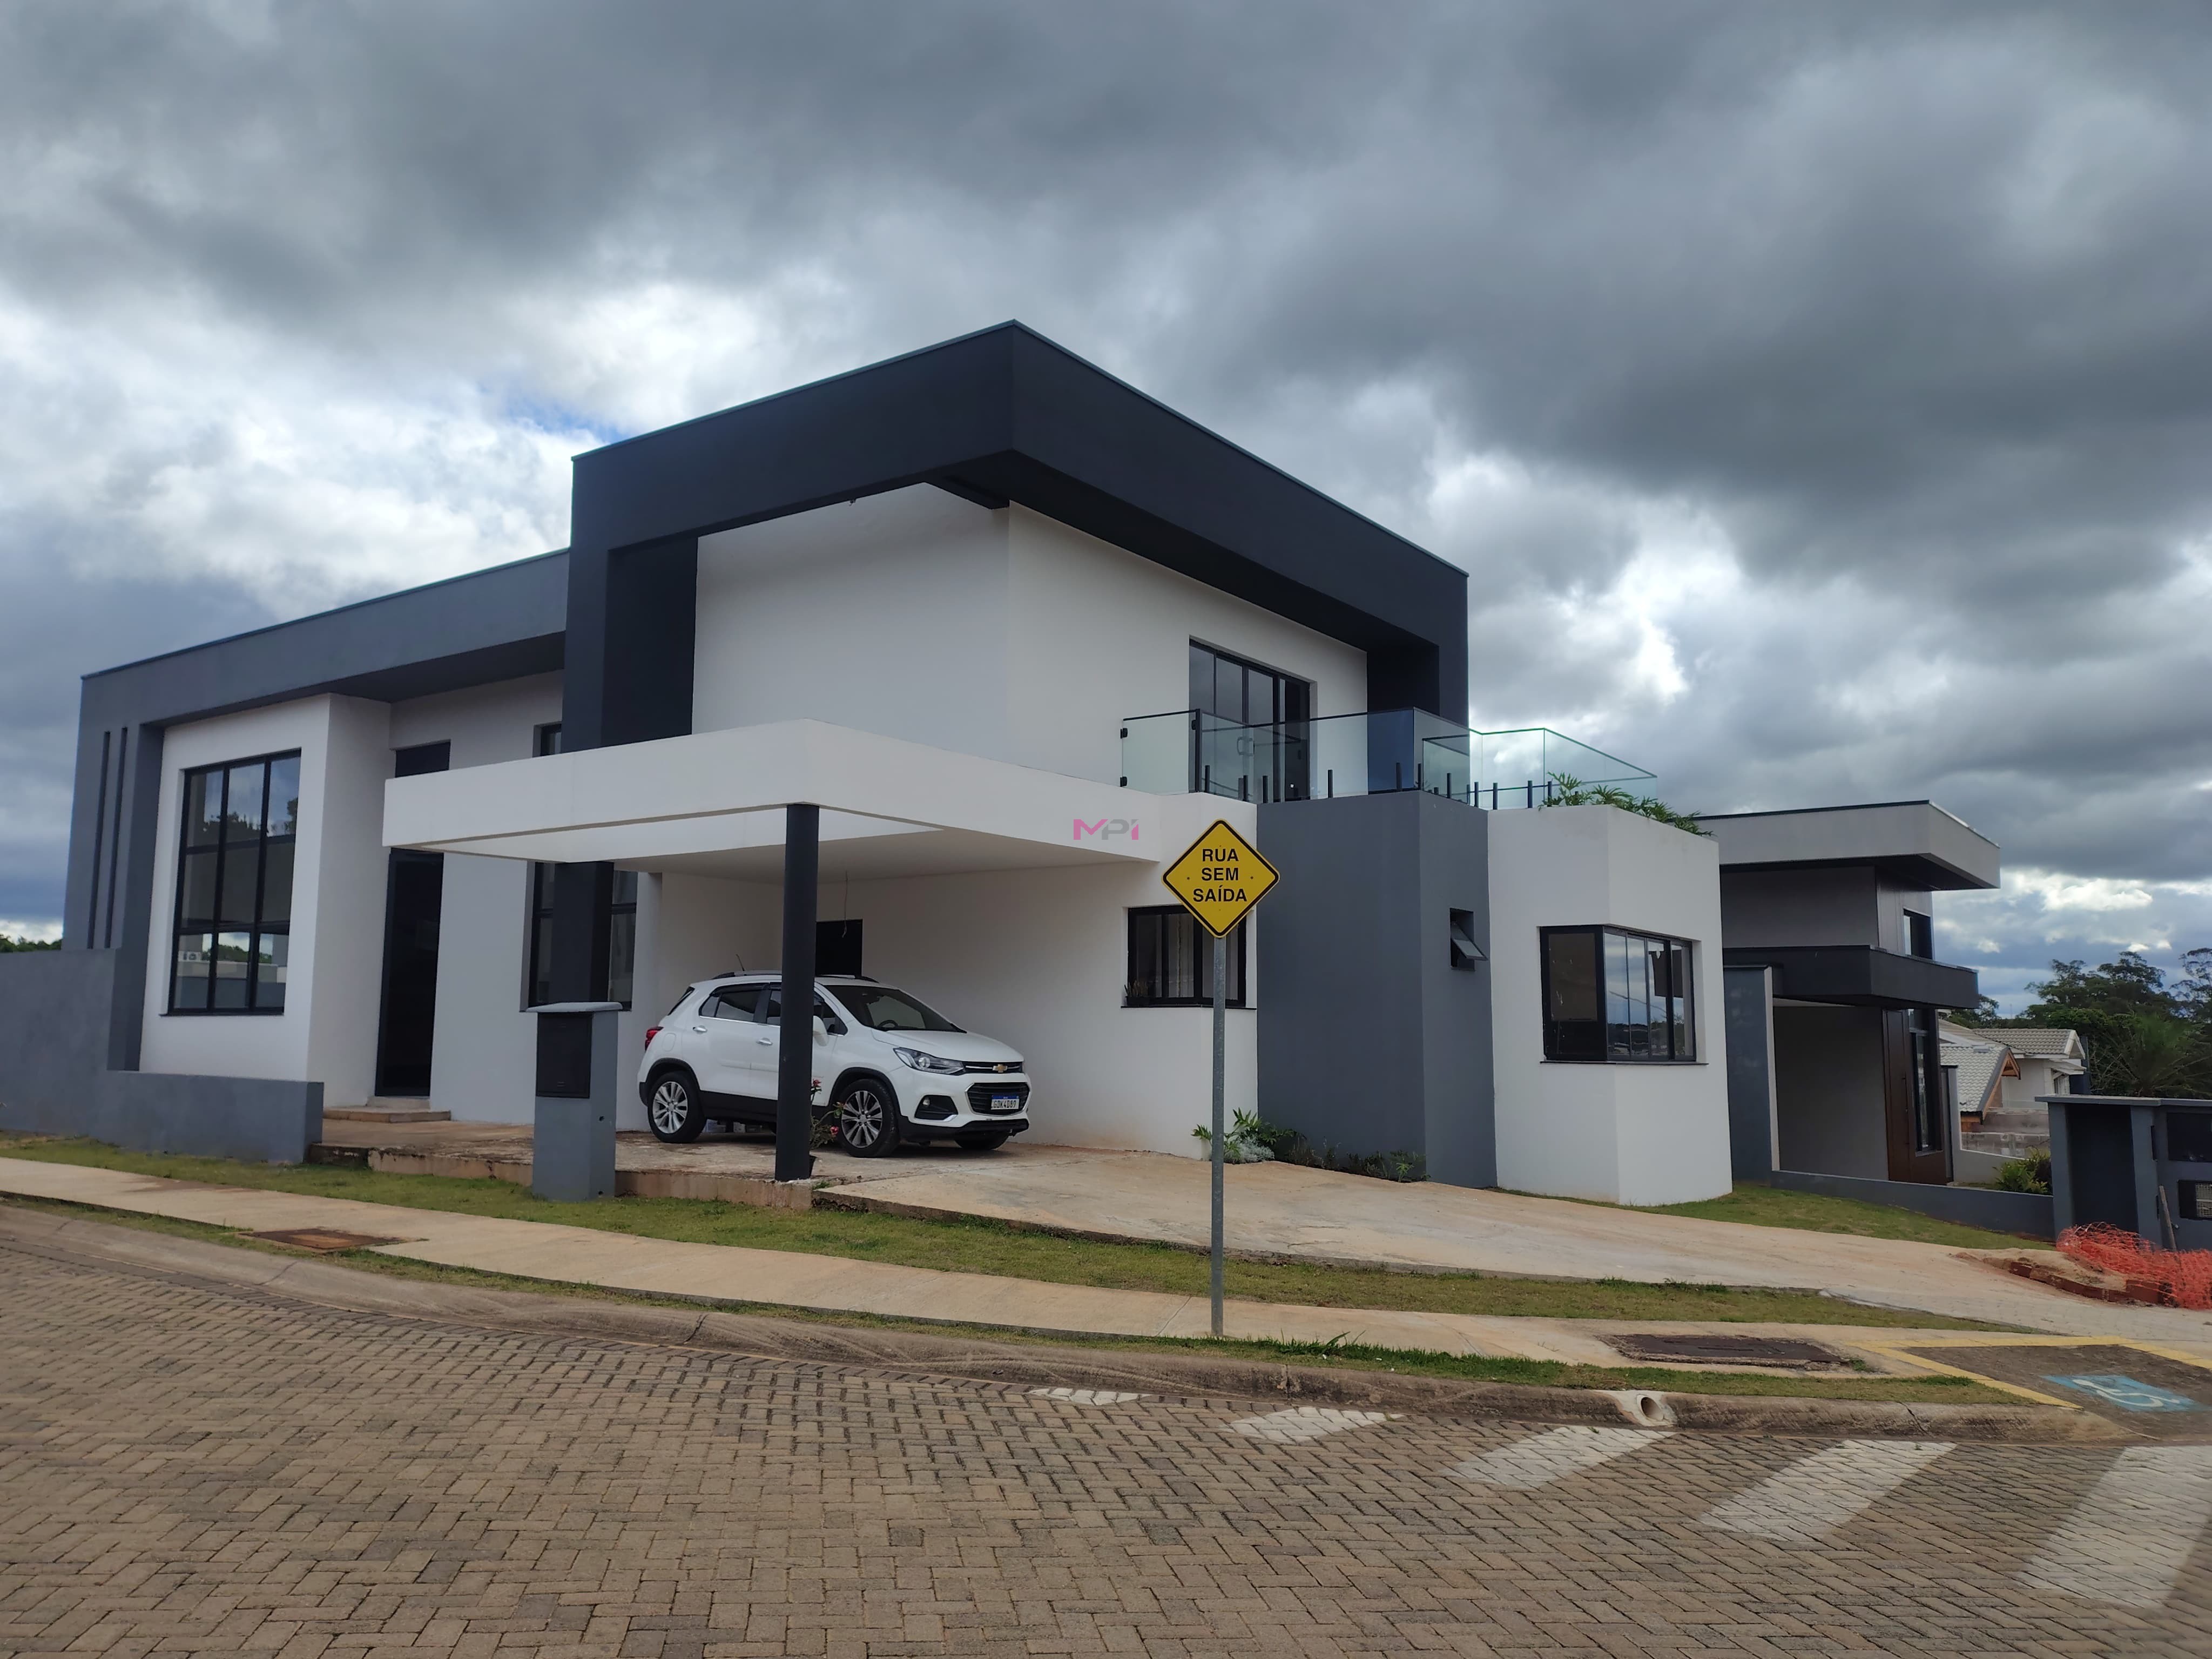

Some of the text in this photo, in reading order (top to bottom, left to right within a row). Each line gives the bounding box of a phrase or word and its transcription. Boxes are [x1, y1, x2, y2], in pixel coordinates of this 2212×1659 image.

[1202, 848, 1239, 862] RUA
[1201, 867, 1239, 881] SEM
[1193, 885, 1247, 902] SAÍDA
